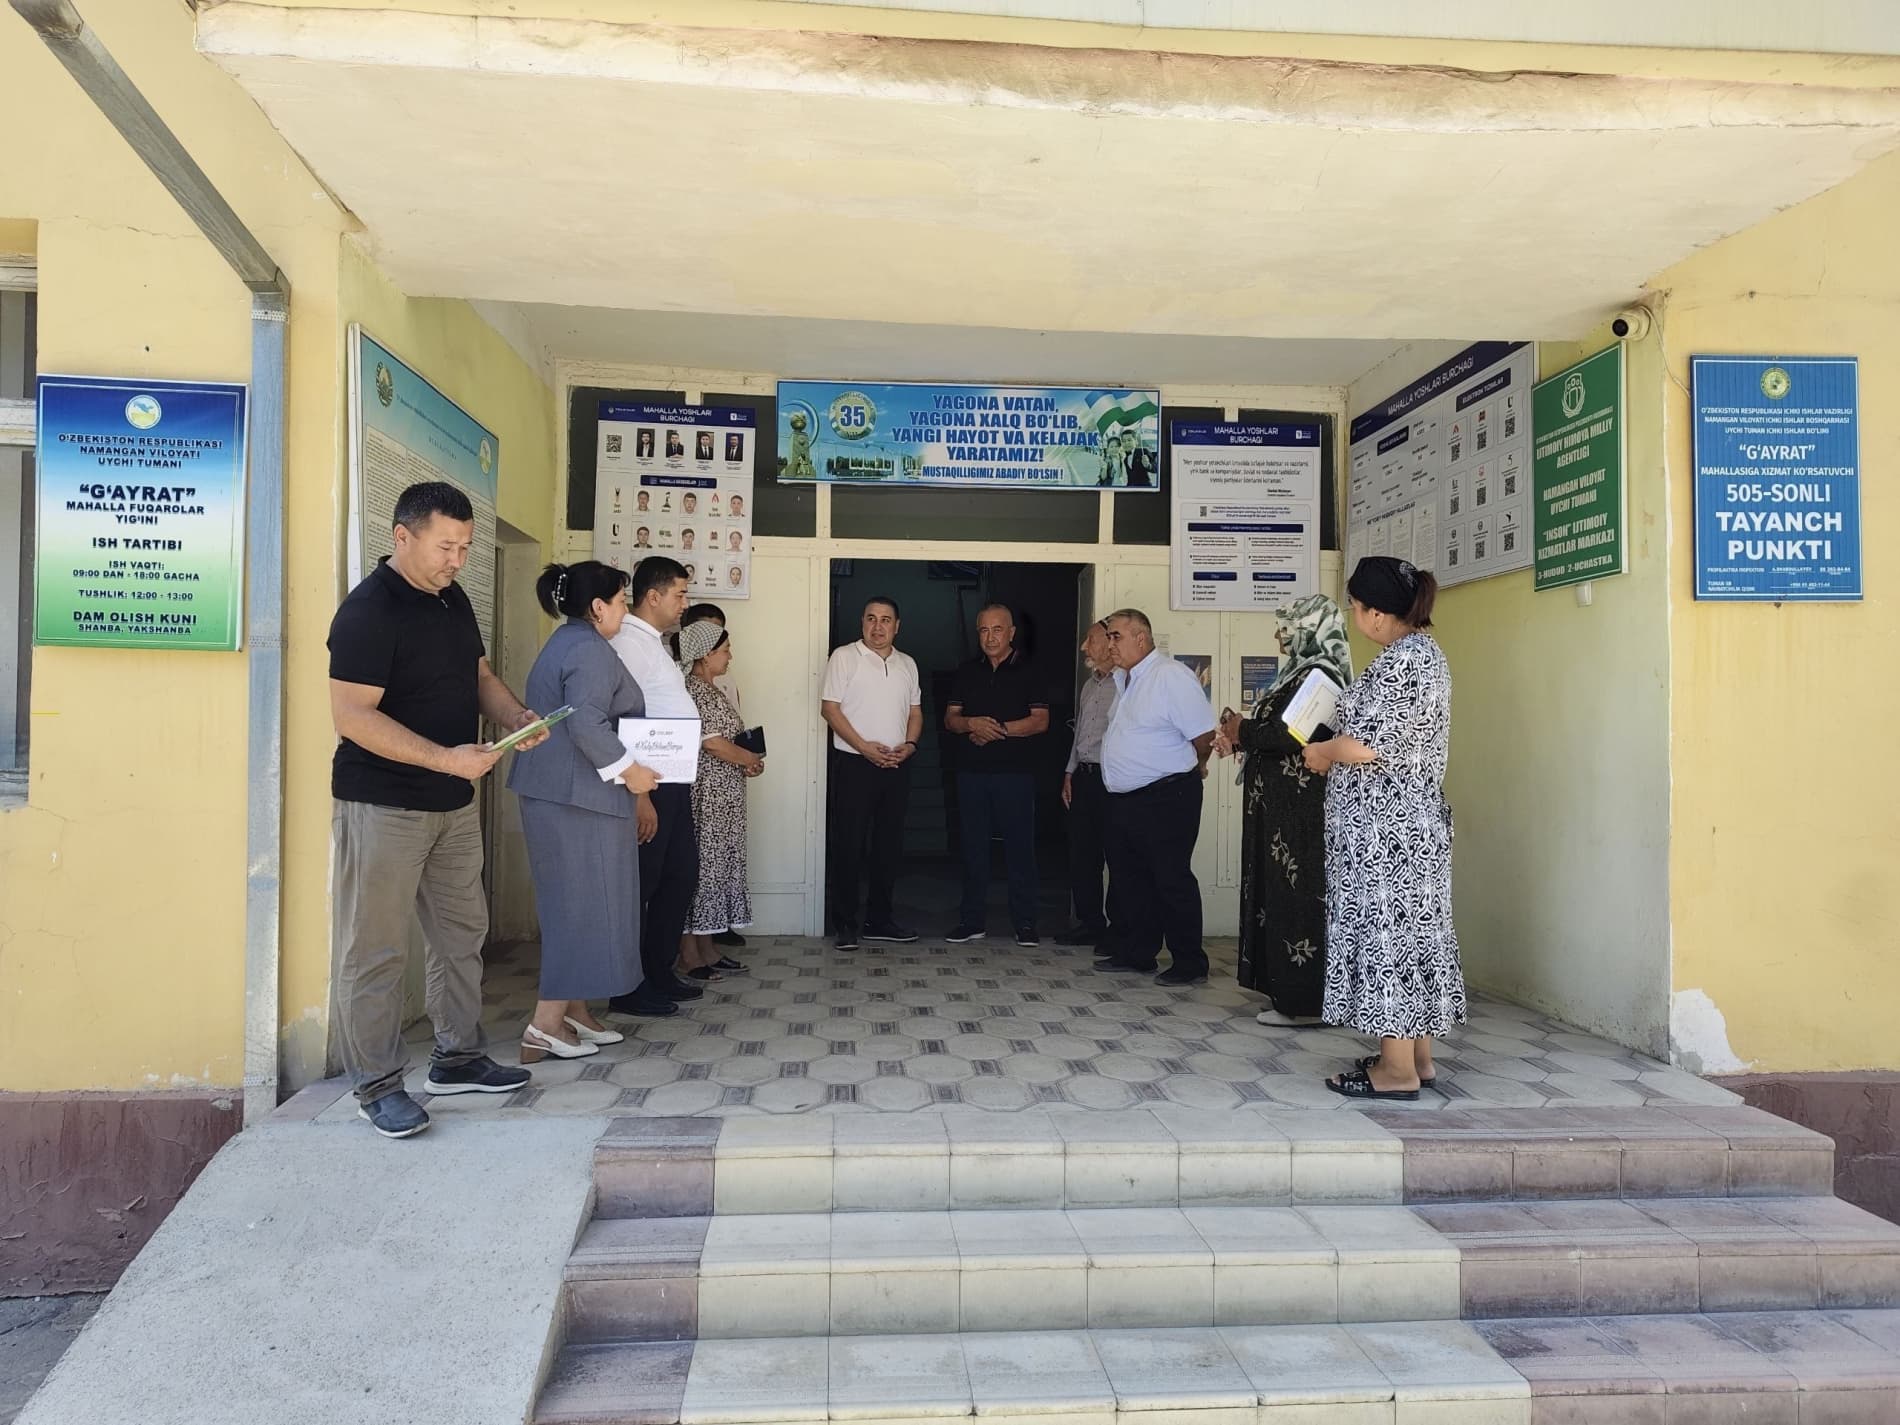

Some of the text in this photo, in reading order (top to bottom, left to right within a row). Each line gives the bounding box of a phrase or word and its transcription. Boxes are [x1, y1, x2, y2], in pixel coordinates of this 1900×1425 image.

[934, 395, 1058, 412] YAGONA VATAN,
[1388, 394, 1413, 415] MAHALLA
[1414, 378, 1441, 400] YOSHLARI
[679, 408, 712, 416] YOSHLARI
[840, 406, 866, 426] 35
[910, 412, 975, 426] YAGONA
[980, 413, 1020, 429] XALQ
[892, 428, 1099, 446] YANGI HAYOT VA KELAJAK
[1247, 427, 1278, 435] YOSHLARI
[1564, 428, 1589, 449] HIMOYA
[1590, 418, 1613, 438] MILLIY
[139, 437, 222, 448] RESPUBLIKASI
[80, 446, 200, 459] NAMANGAN VILOYATI
[946, 446, 1044, 462] YARATAMIZ!
[1557, 444, 1590, 468] AGENTLIGI
[98, 457, 182, 468] UYCHI TUMANI
[922, 466, 994, 479] MUSTAQILLIGIMIZ
[996, 468, 1025, 479] ABADIY
[1701, 467, 1759, 476] MAHALLASIGA
[1761, 467, 1790, 476] XIZMAT
[1544, 468, 1606, 501] NAMANGAN VILOYAT
[1727, 484, 1830, 502] 505-SONLI
[66, 501, 204, 515] MAHALLA FUQAROLAR
[1551, 489, 1597, 515] UYCHI TUMANI
[1573, 512, 1608, 534] IJTIMOIY
[1716, 512, 1842, 532] TAYANCH
[93, 537, 182, 551] ISH TARTIBI
[1538, 528, 1614, 560] XIZMATLAR MARKAZI
[1728, 540, 1831, 560] PUNKTI
[109, 560, 165, 570] ISH VAQTI:
[1568, 554, 1613, 572] 2-UCHASTKA
[73, 569, 100, 577] 09:00
[103, 570, 124, 578] DAN
[164, 572, 200, 581] GACHA
[79, 590, 128, 599] TUSHLIK:
[73, 611, 197, 625] DAM OLISH KUNI
[79, 624, 191, 634] SHANBA, YAKSHANBA
